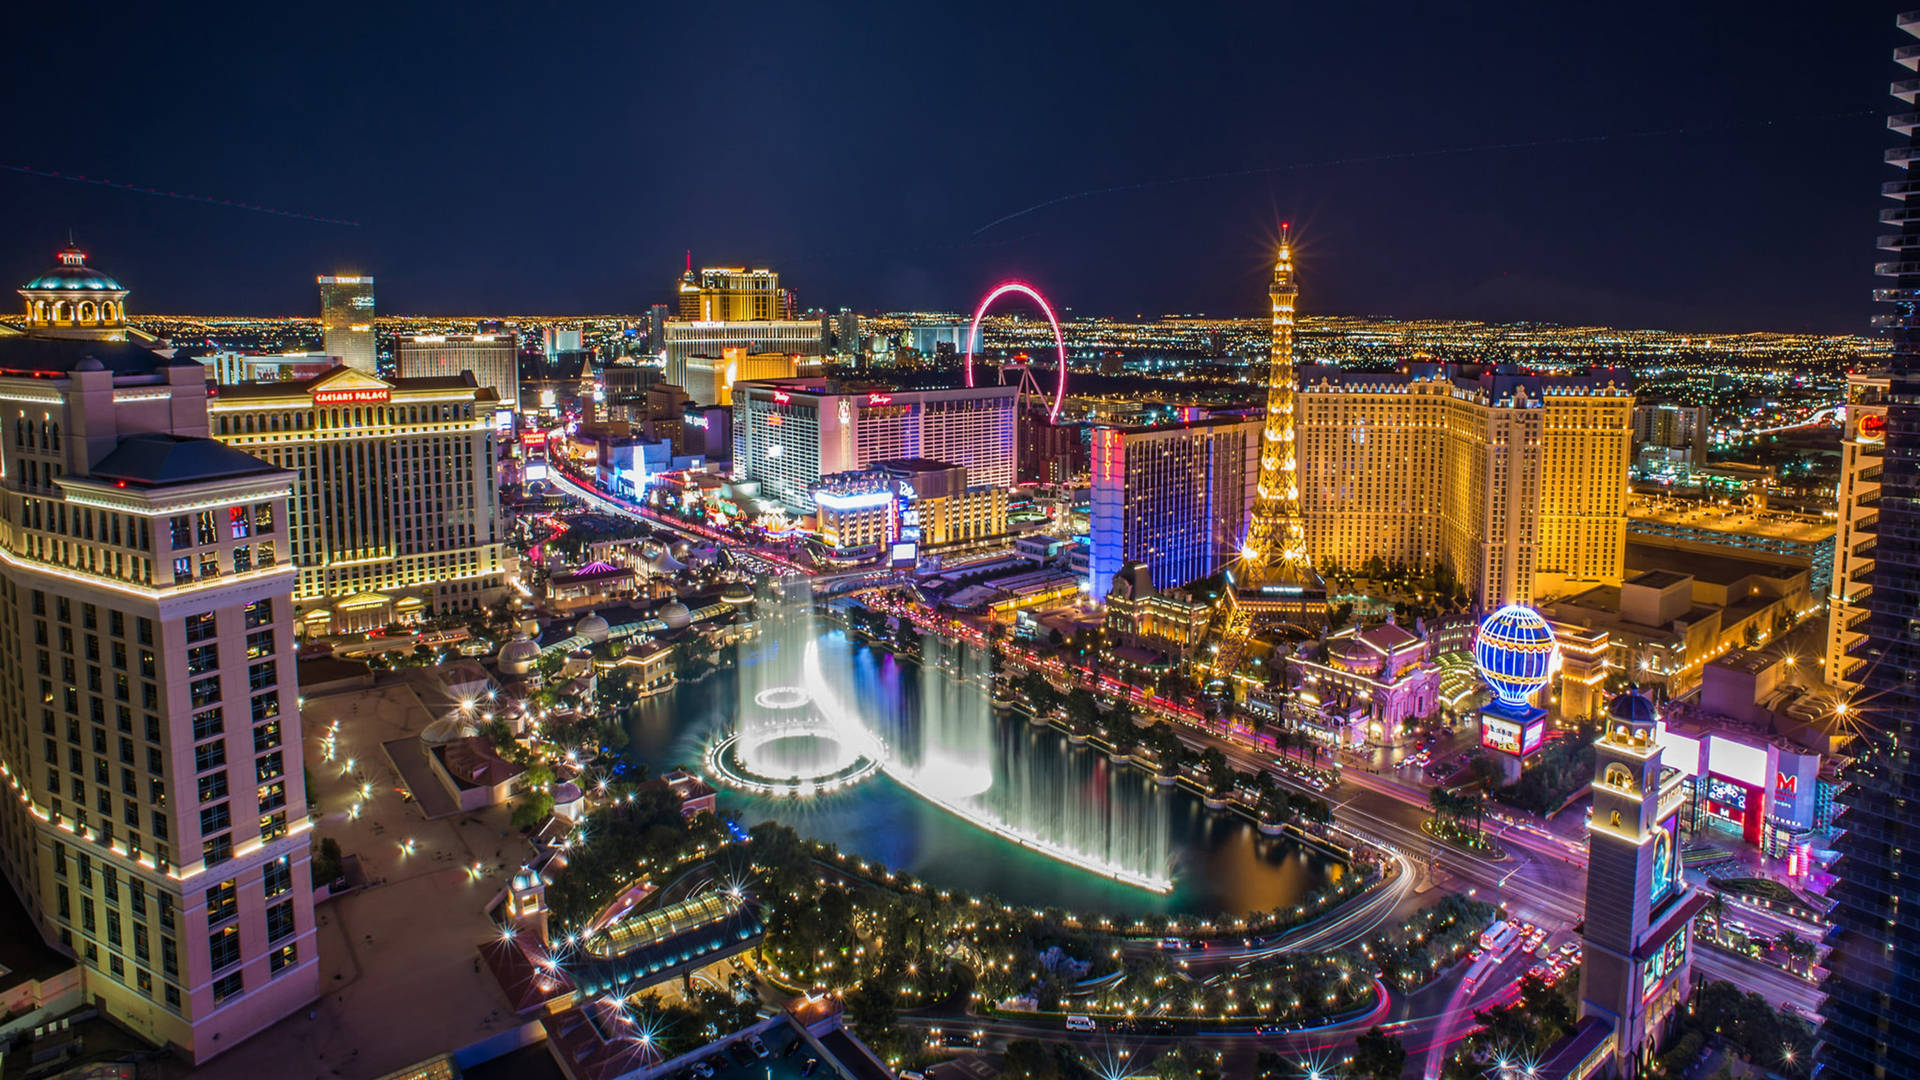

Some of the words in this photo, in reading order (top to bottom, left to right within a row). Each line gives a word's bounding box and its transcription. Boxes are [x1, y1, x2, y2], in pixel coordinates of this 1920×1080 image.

[316, 393, 353, 402] CAESARS
[355, 391, 388, 400] PALACE
[1777, 771, 1798, 793] M
